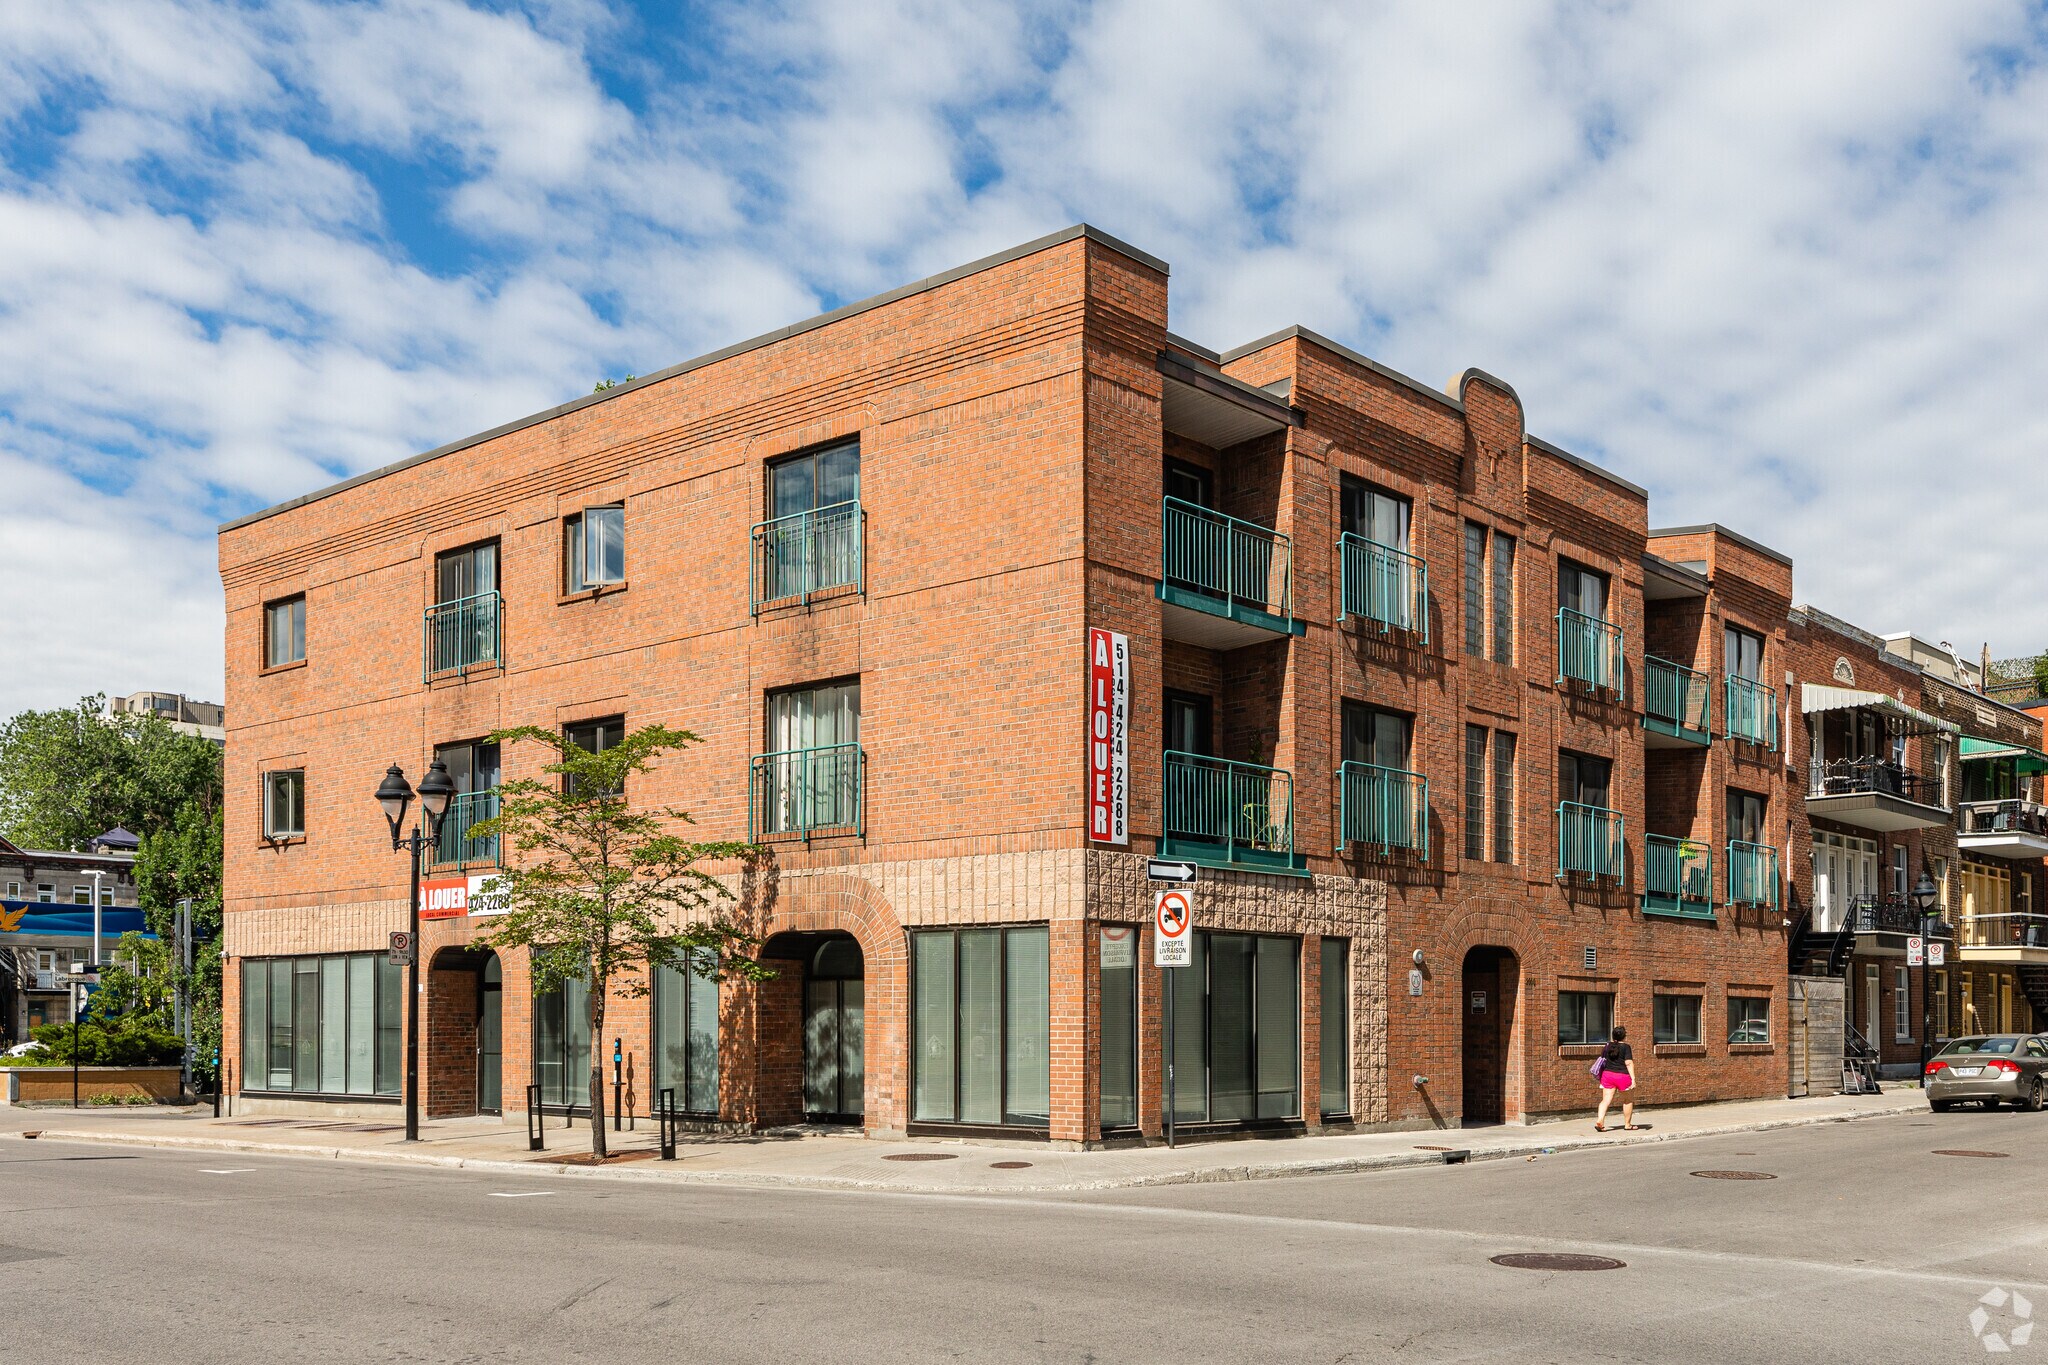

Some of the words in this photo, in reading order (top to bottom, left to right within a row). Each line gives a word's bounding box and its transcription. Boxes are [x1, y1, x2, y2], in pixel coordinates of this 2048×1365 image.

[1095, 633, 1109, 668] À
[1094, 678, 1108, 834] LOUER
[1115, 643, 1124, 837] 514-424-2288
[419, 886, 428, 911] À
[428, 886, 466, 910] LOUER
